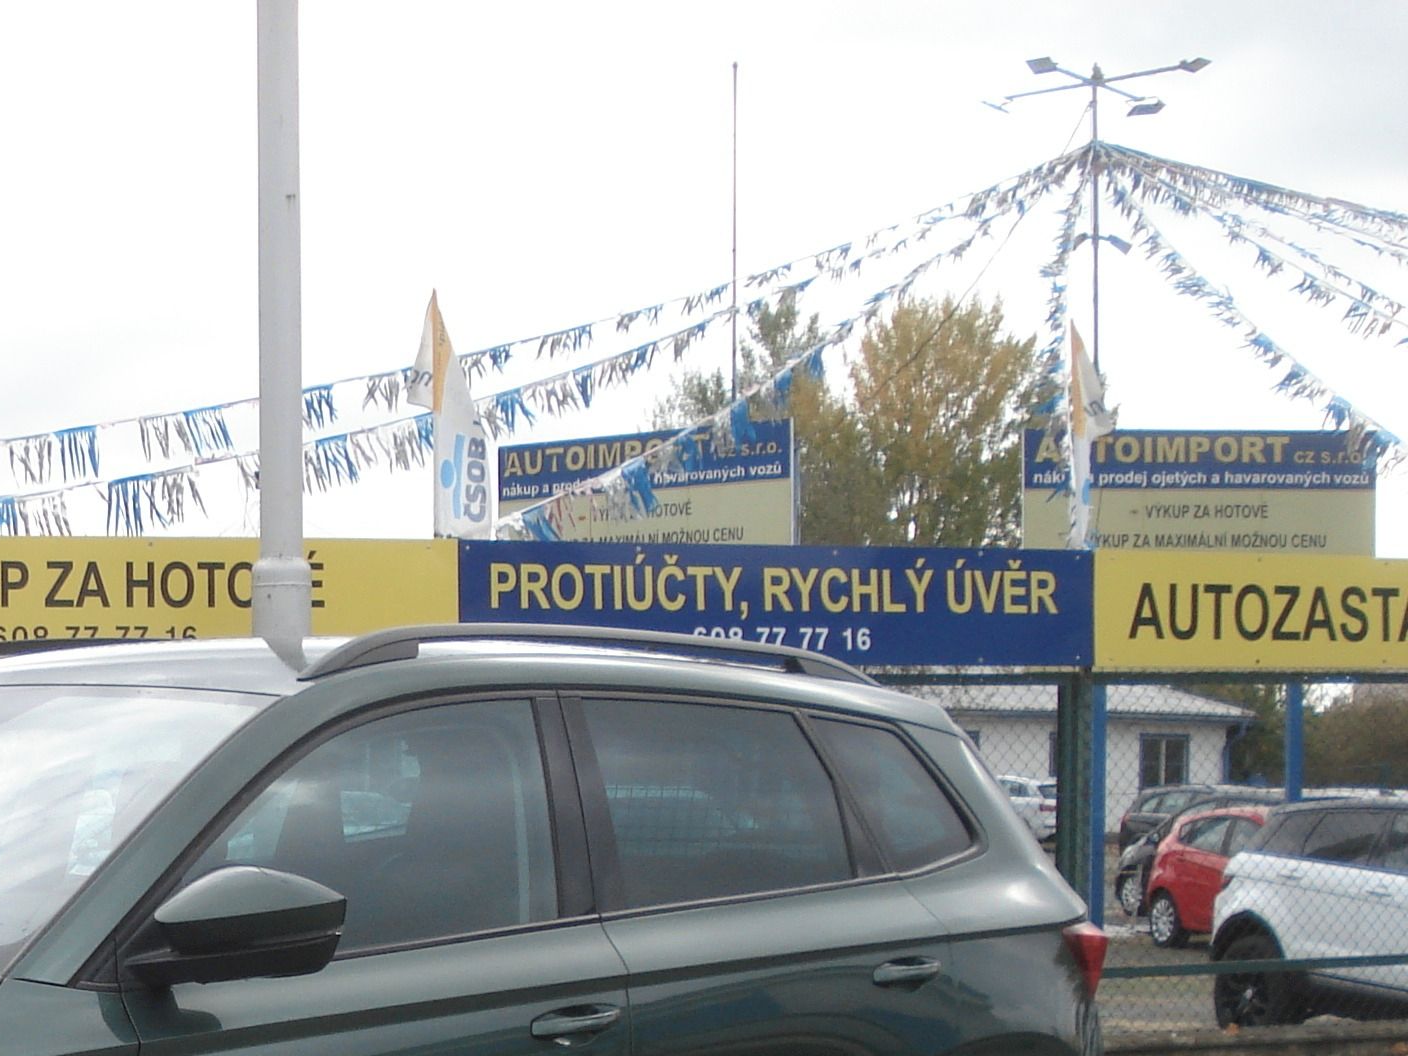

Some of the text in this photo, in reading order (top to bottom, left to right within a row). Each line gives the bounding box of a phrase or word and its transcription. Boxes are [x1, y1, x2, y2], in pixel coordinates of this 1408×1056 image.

[503, 431, 709, 478] AUTOIMPOT
[741, 442, 782, 457] s.r.o.
[1034, 435, 1362, 464] ATOIMPORT cz s.r.o
[464, 437, 487, 522] ČSOB
[502, 482, 539, 498] nákup
[542, 484, 549, 493] a
[750, 461, 782, 476] vozů
[1033, 470, 1065, 485] nák
[1099, 470, 1147, 488] prodej
[1151, 470, 1207, 487] ojetých
[1211, 473, 1220, 484] a
[1224, 471, 1330, 487] havarovaných
[1334, 471, 1369, 484] vozů
[1193, 504, 1210, 518] ZA
[713, 526, 744, 541] CENU
[1133, 533, 1151, 548] ZA
[1155, 531, 1228, 548] MAXIMÁLNÍ
[1232, 531, 1286, 548] MOŽNOU
[1292, 534, 1327, 548] CENU
[44, 561, 111, 609] ZA
[126, 550, 325, 608] HOTOÉ
[490, 554, 1059, 620] PROTIÚČTY, RYCHLÝ ÚVĚR
[756, 626, 786, 646] 77
[799, 627, 829, 650] 77
[842, 627, 872, 651] 16
